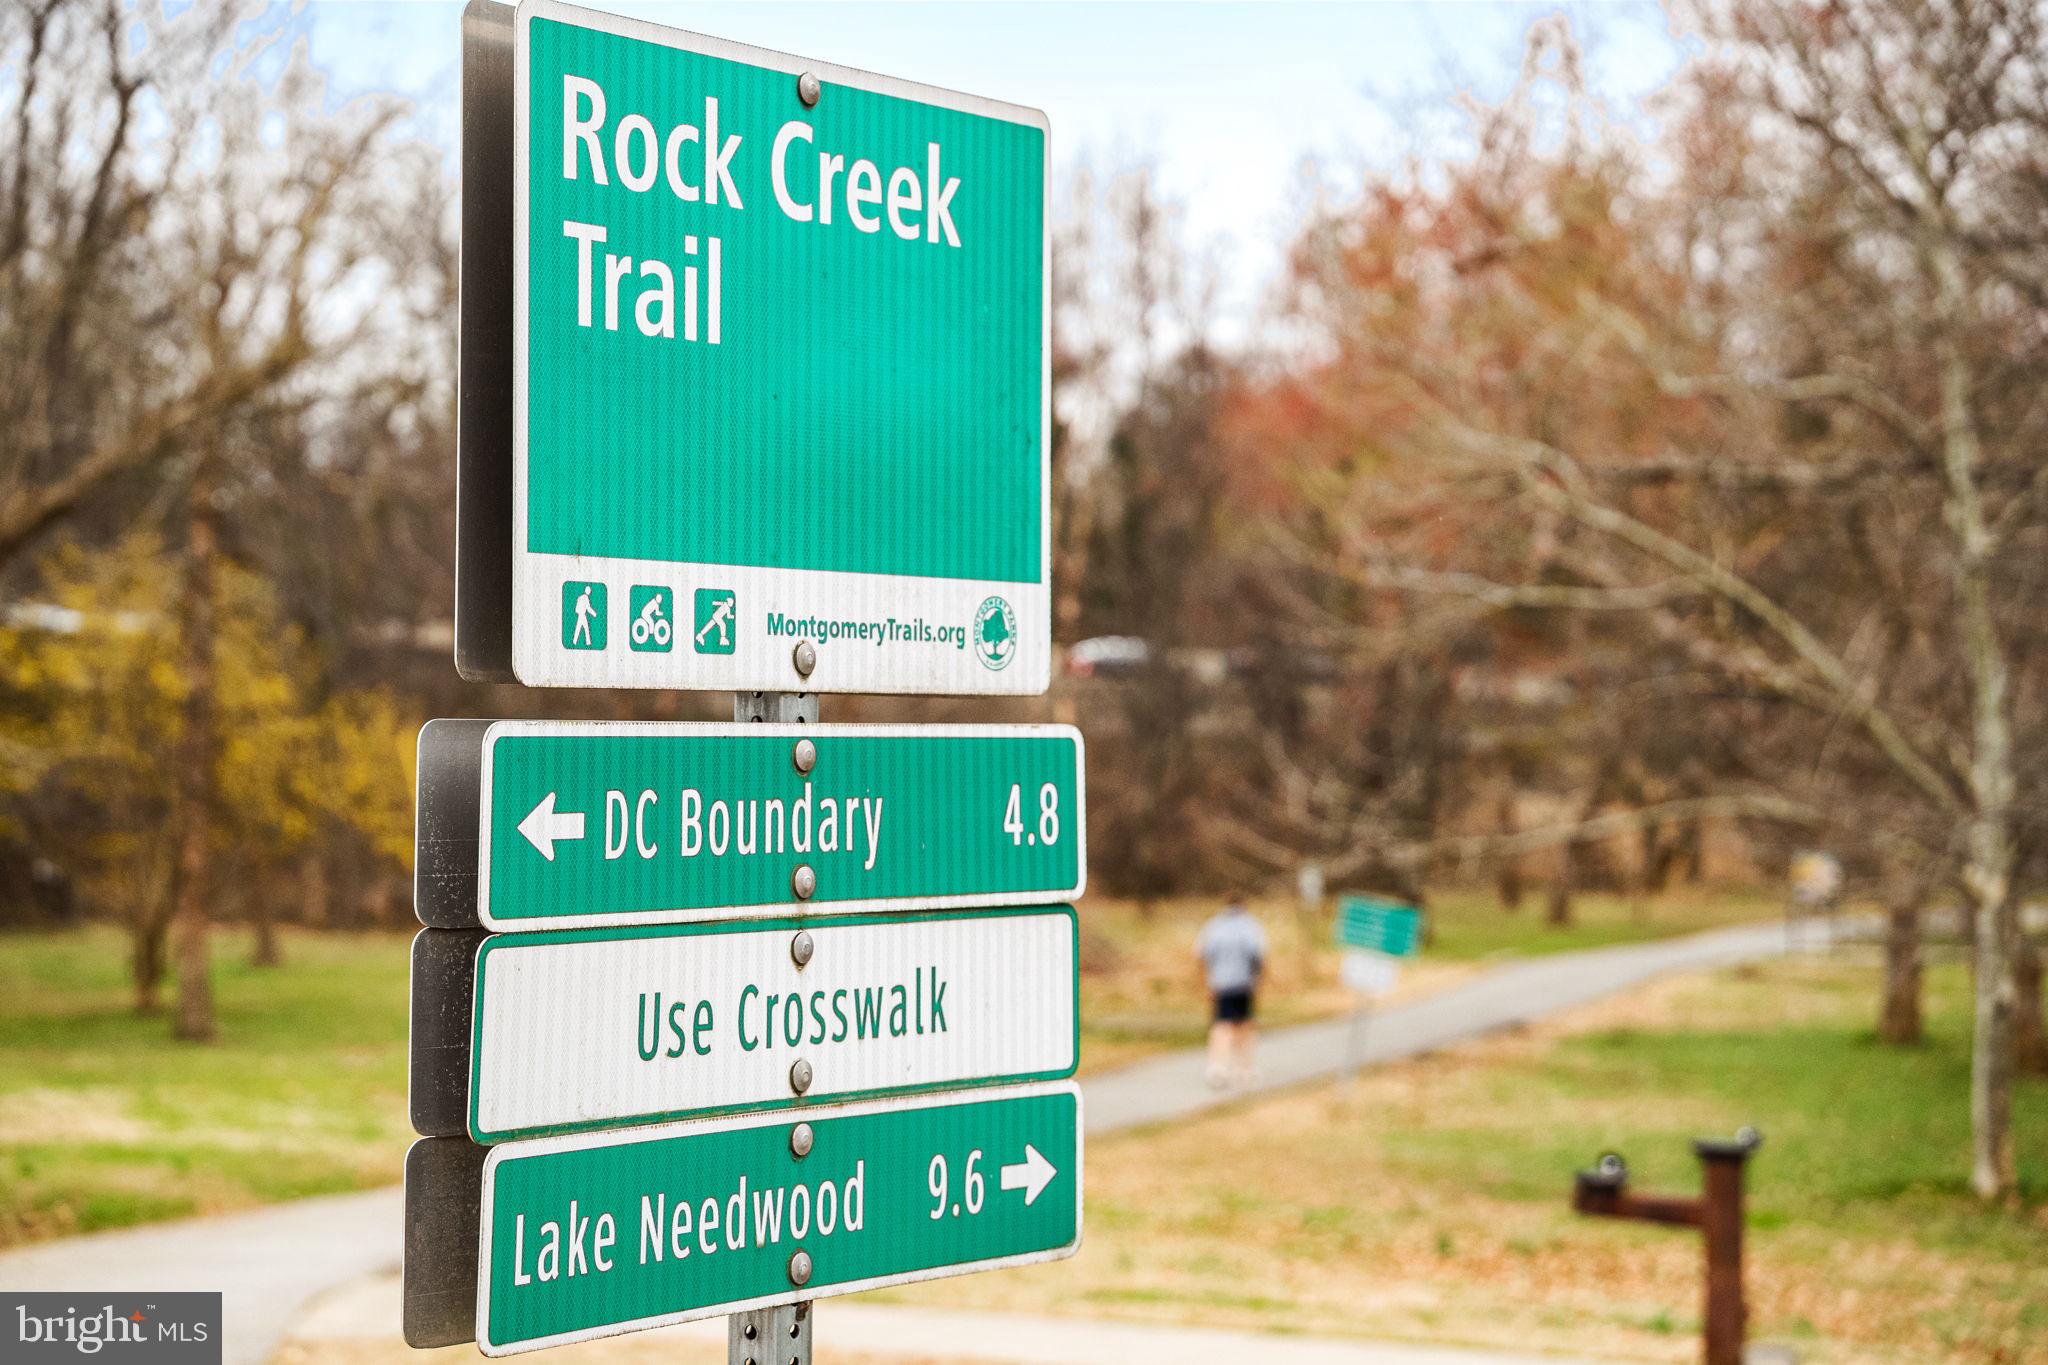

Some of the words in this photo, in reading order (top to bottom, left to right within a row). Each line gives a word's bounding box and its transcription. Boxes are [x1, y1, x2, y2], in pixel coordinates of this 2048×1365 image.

[563, 75, 743, 210] Rock
[771, 121, 962, 248] Creek
[563, 221, 721, 345] Trail
[767, 612, 966, 649] MontgomeryTrails.org
[604, 789, 659, 860] DC
[681, 782, 884, 870] Boundary
[1003, 782, 1059, 846] 4.8
[637, 991, 714, 1061] Use
[738, 966, 950, 1052] Crosswalk
[514, 1200, 614, 1287] Lake
[640, 1160, 865, 1265] Needwood
[927, 1149, 984, 1220] 9.6
